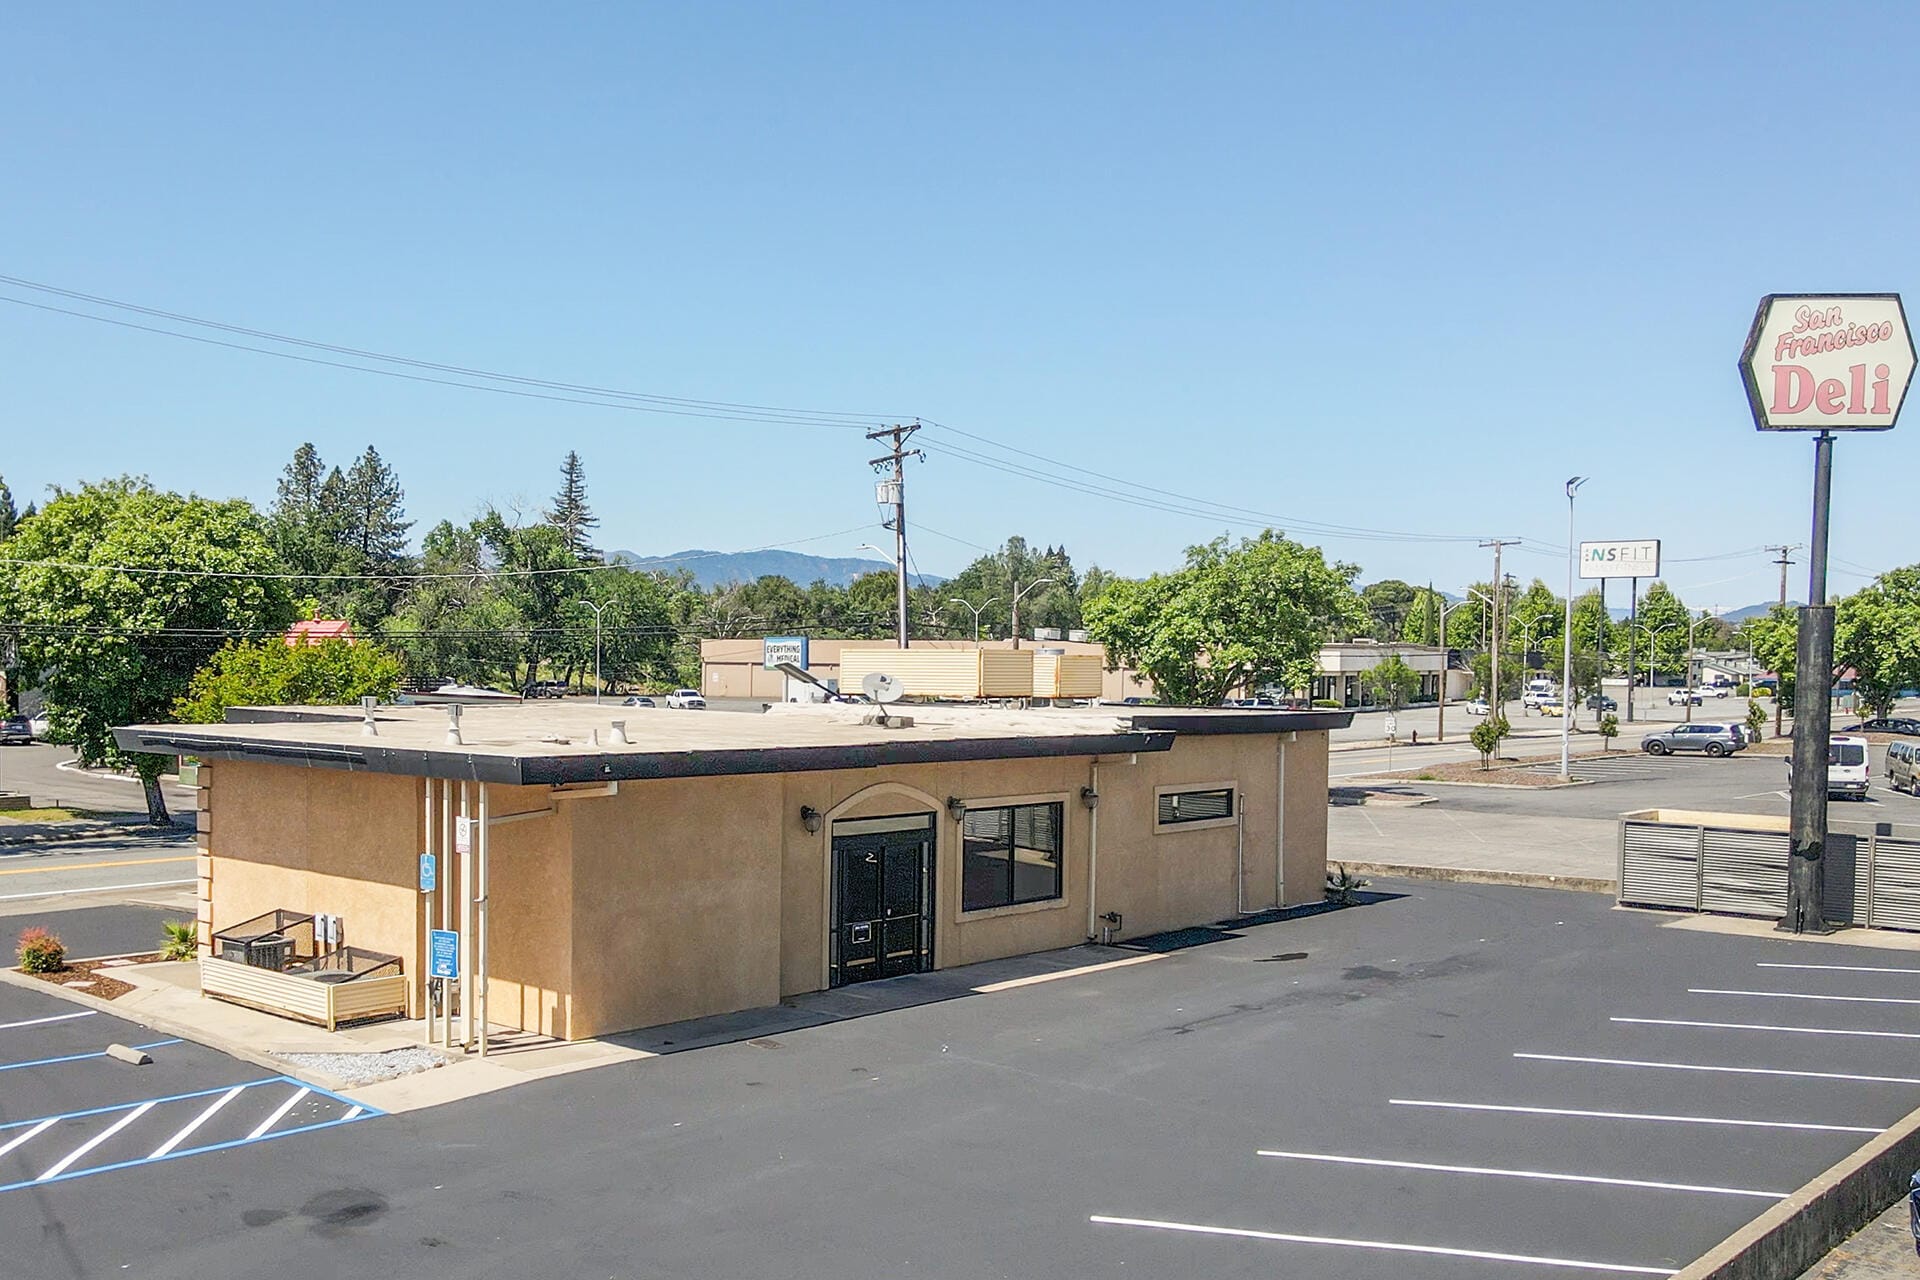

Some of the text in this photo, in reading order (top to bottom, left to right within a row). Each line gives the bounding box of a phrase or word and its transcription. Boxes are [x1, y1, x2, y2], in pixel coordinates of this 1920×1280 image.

[1792, 305, 1843, 333] San
[1774, 321, 1893, 362] Francisco
[1770, 363, 1891, 415] Deli
[767, 645, 800, 654] EVERYTHING
[776, 654, 800, 663] MEDICAL
